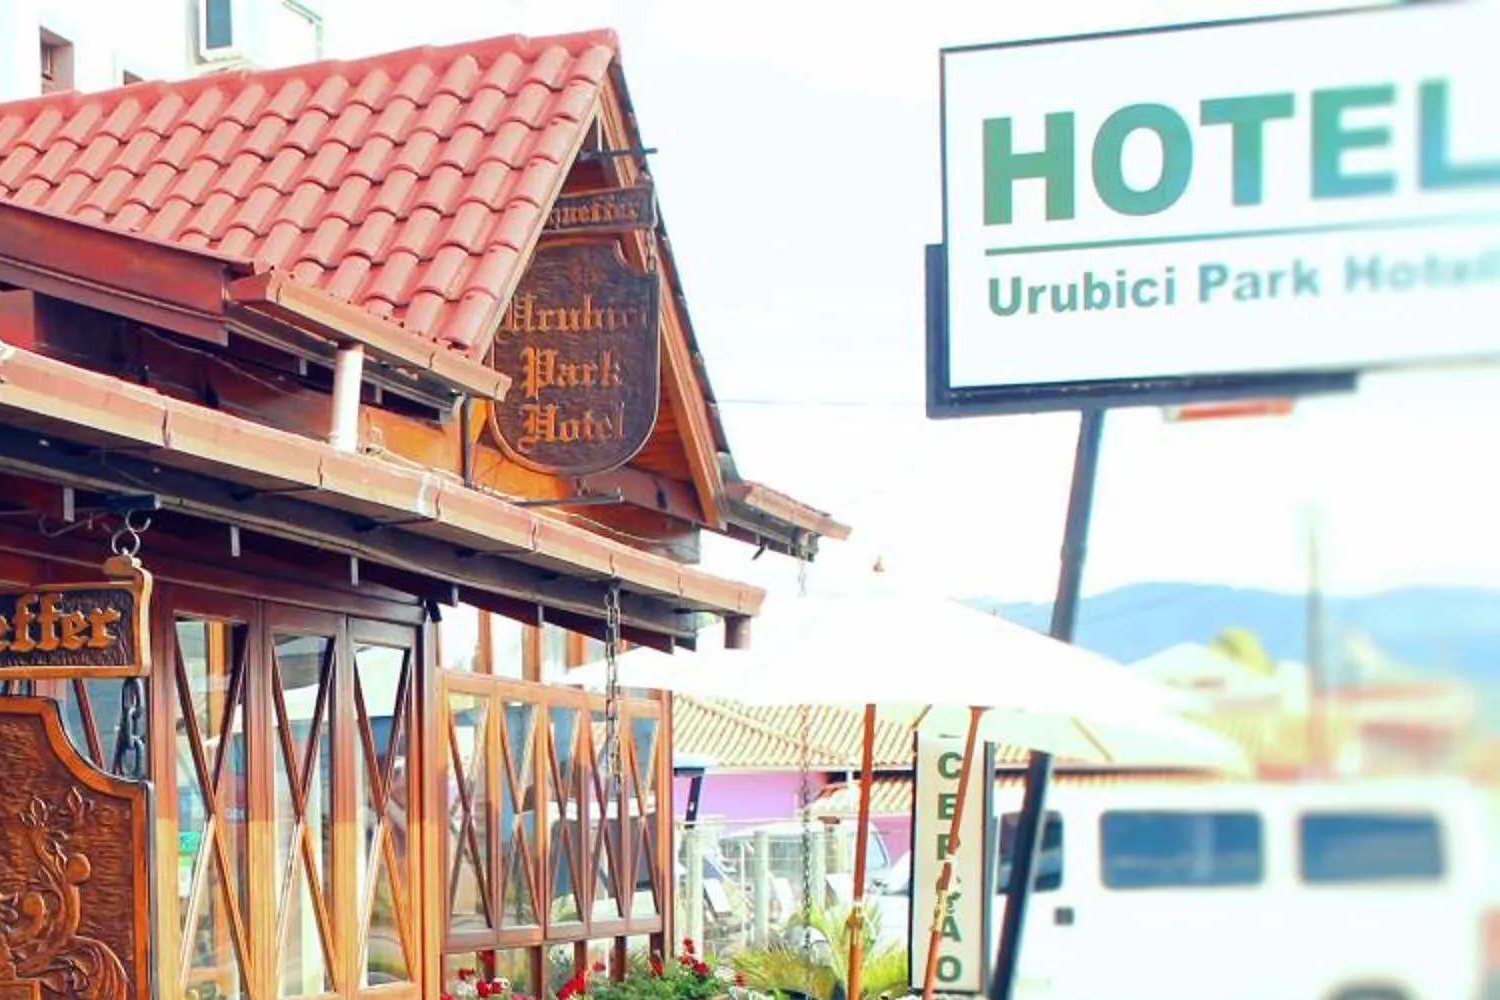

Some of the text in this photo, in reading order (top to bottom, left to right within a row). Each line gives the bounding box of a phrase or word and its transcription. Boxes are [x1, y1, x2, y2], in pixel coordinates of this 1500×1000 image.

[982, 76, 1500, 226] HOTEL
[988, 266, 1176, 317] Urubici
[1198, 258, 1320, 303] Park
[518, 347, 623, 399] Park
[516, 402, 626, 452] Hotel
